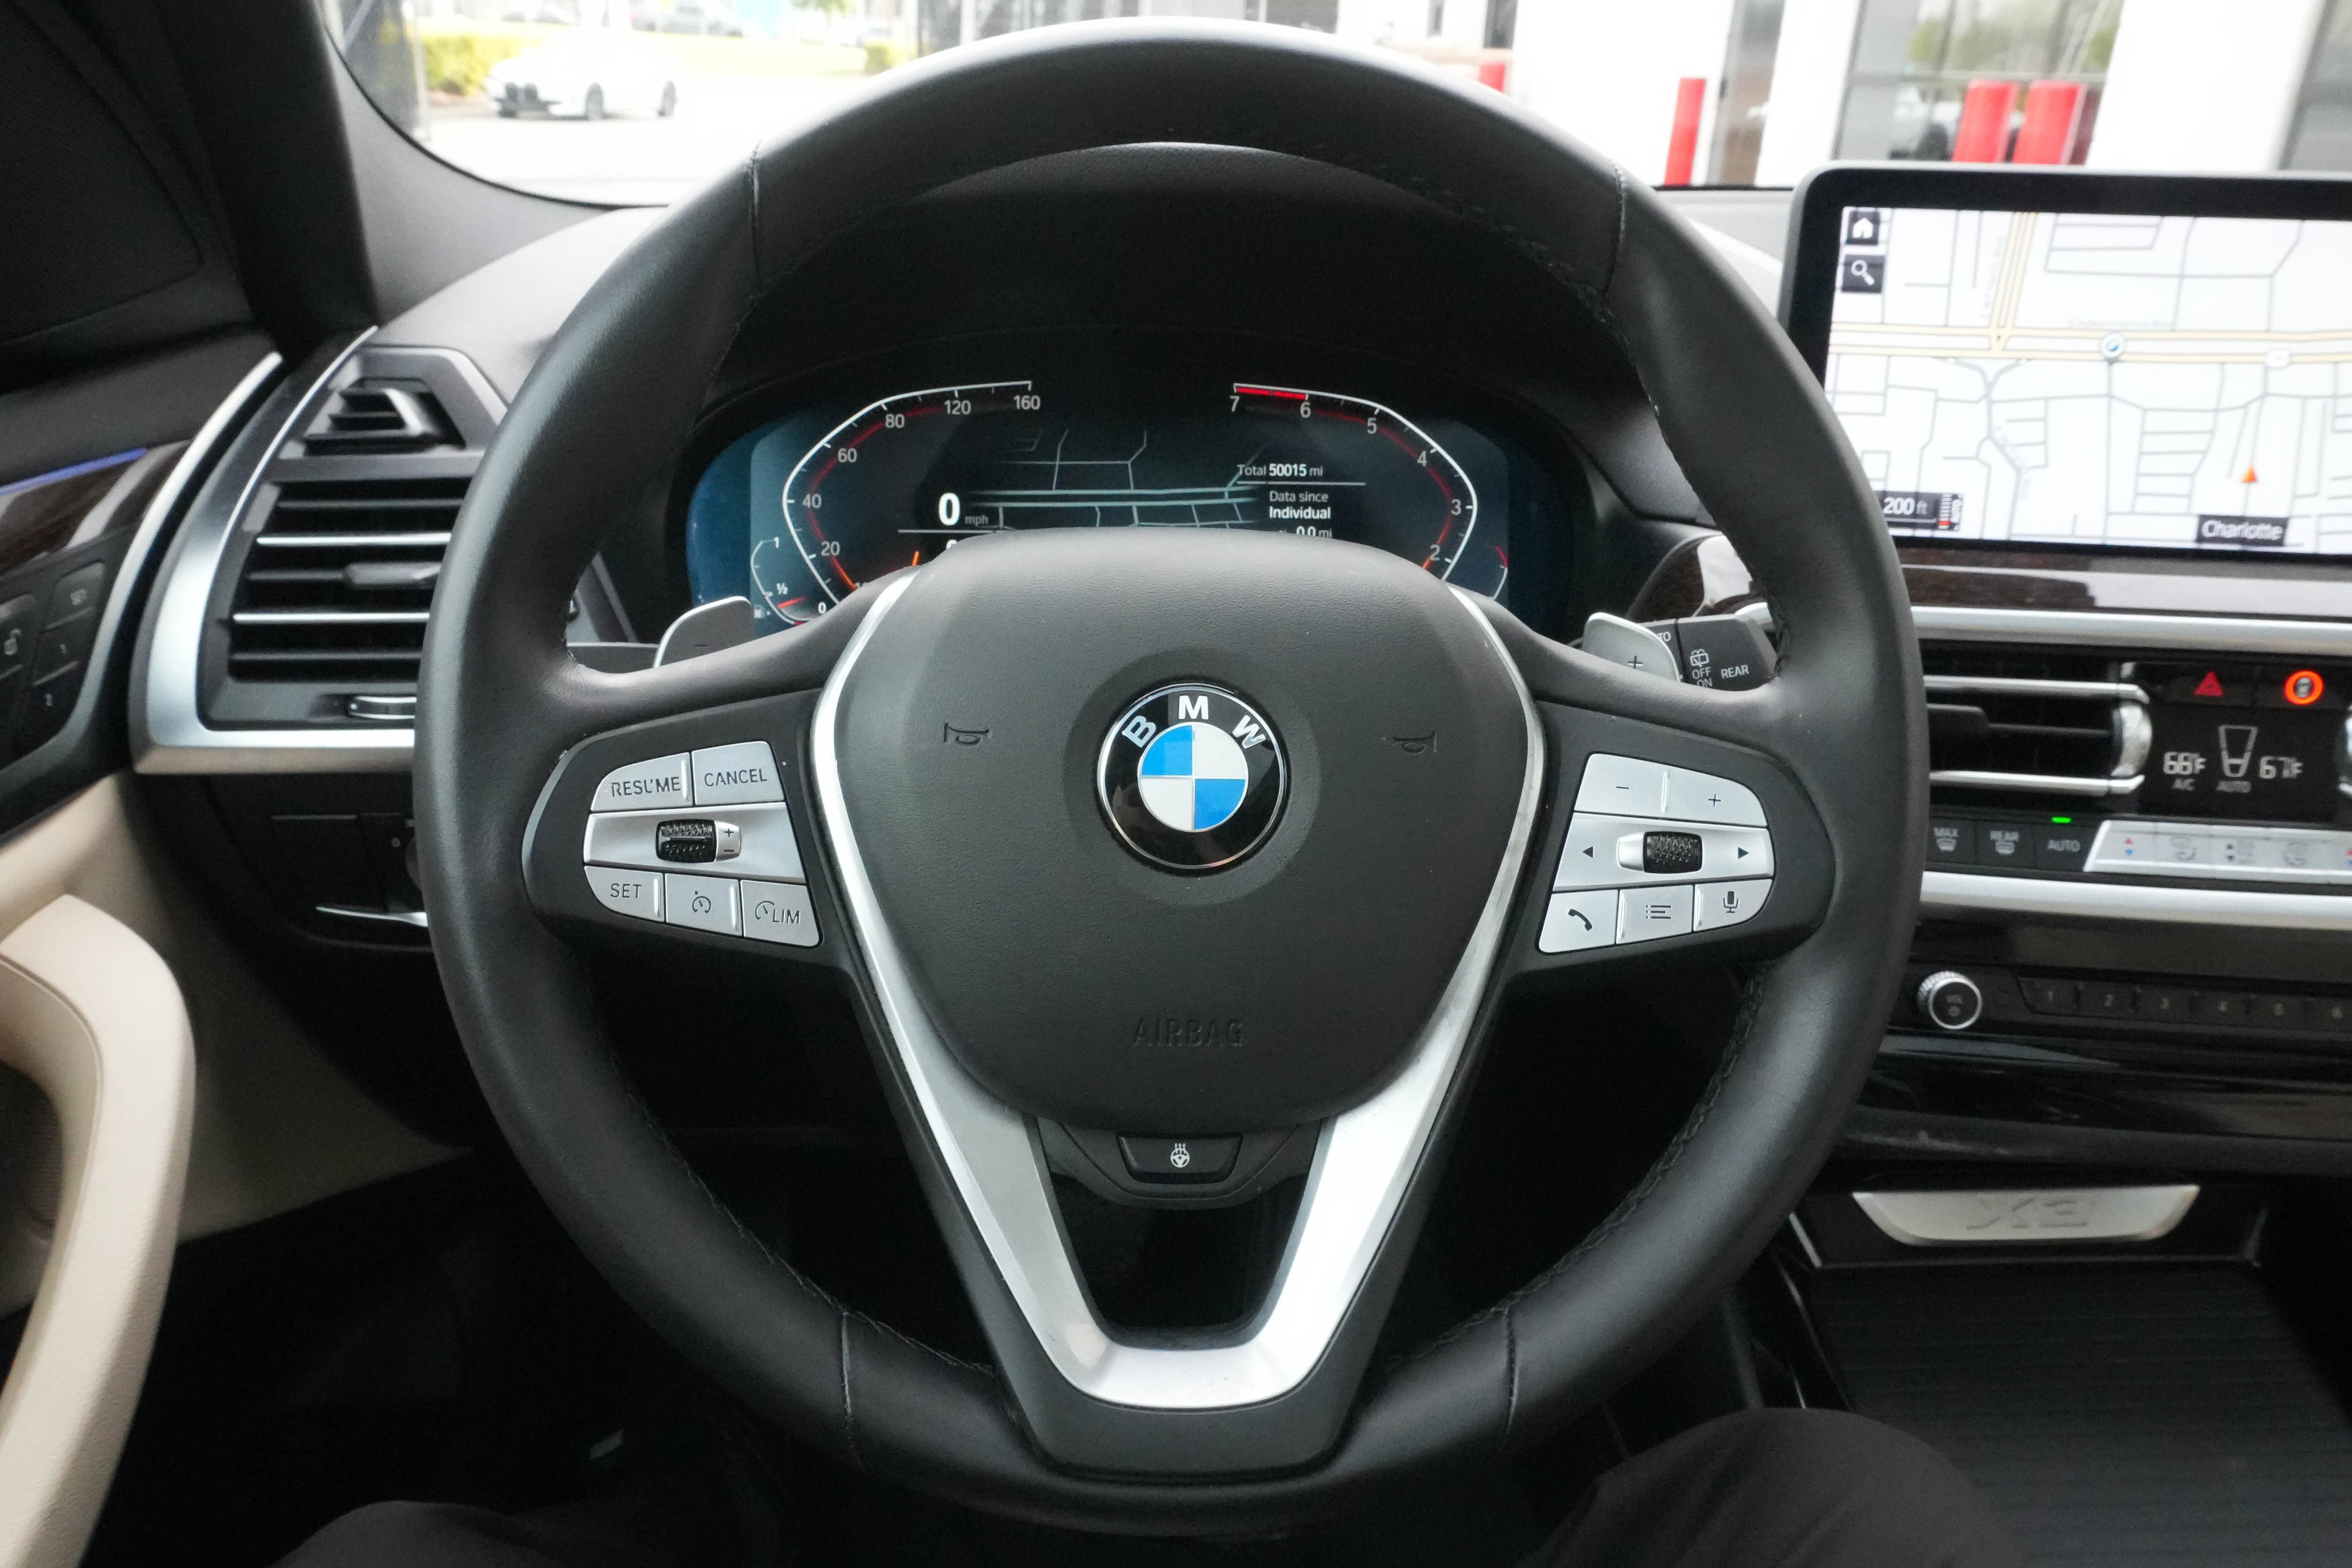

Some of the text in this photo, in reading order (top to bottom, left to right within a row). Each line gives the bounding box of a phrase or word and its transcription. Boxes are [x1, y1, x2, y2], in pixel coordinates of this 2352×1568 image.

[944, 400, 971, 415] 120
[1013, 395, 1040, 411] 160
[1230, 395, 1240, 412] 7
[1300, 402, 1311, 418] 6
[885, 414, 904, 429] 80
[1366, 419, 1377, 434] 5
[838, 448, 857, 463] 60
[1416, 451, 1427, 466] 4
[1237, 463, 1323, 477] Total 50015 mi
[802, 494, 821, 509] 40
[1270, 490, 1329, 502] Data since
[939, 492, 988, 526] 0 mph
[1270, 506, 1331, 519] Individual
[1450, 499, 1461, 515] 3
[1883, 496, 1915, 515] 200
[2202, 520, 2283, 540] Charlotte
[774, 536, 779, 548] 1
[821, 541, 840, 556] 20
[1429, 545, 1440, 560] 2
[818, 601, 827, 614] 0
[1692, 667, 1712, 679] OFF
[1721, 665, 1750, 679] REAR
[1122, 695, 1266, 749] BMW
[704, 768, 768, 788] CANCEL
[611, 776, 681, 798] RESUME
[2047, 839, 2081, 852] AUTO
[610, 883, 642, 899] SET
[772, 909, 801, 925] LIM
[1133, 1019, 1243, 1046] AIRBAG
